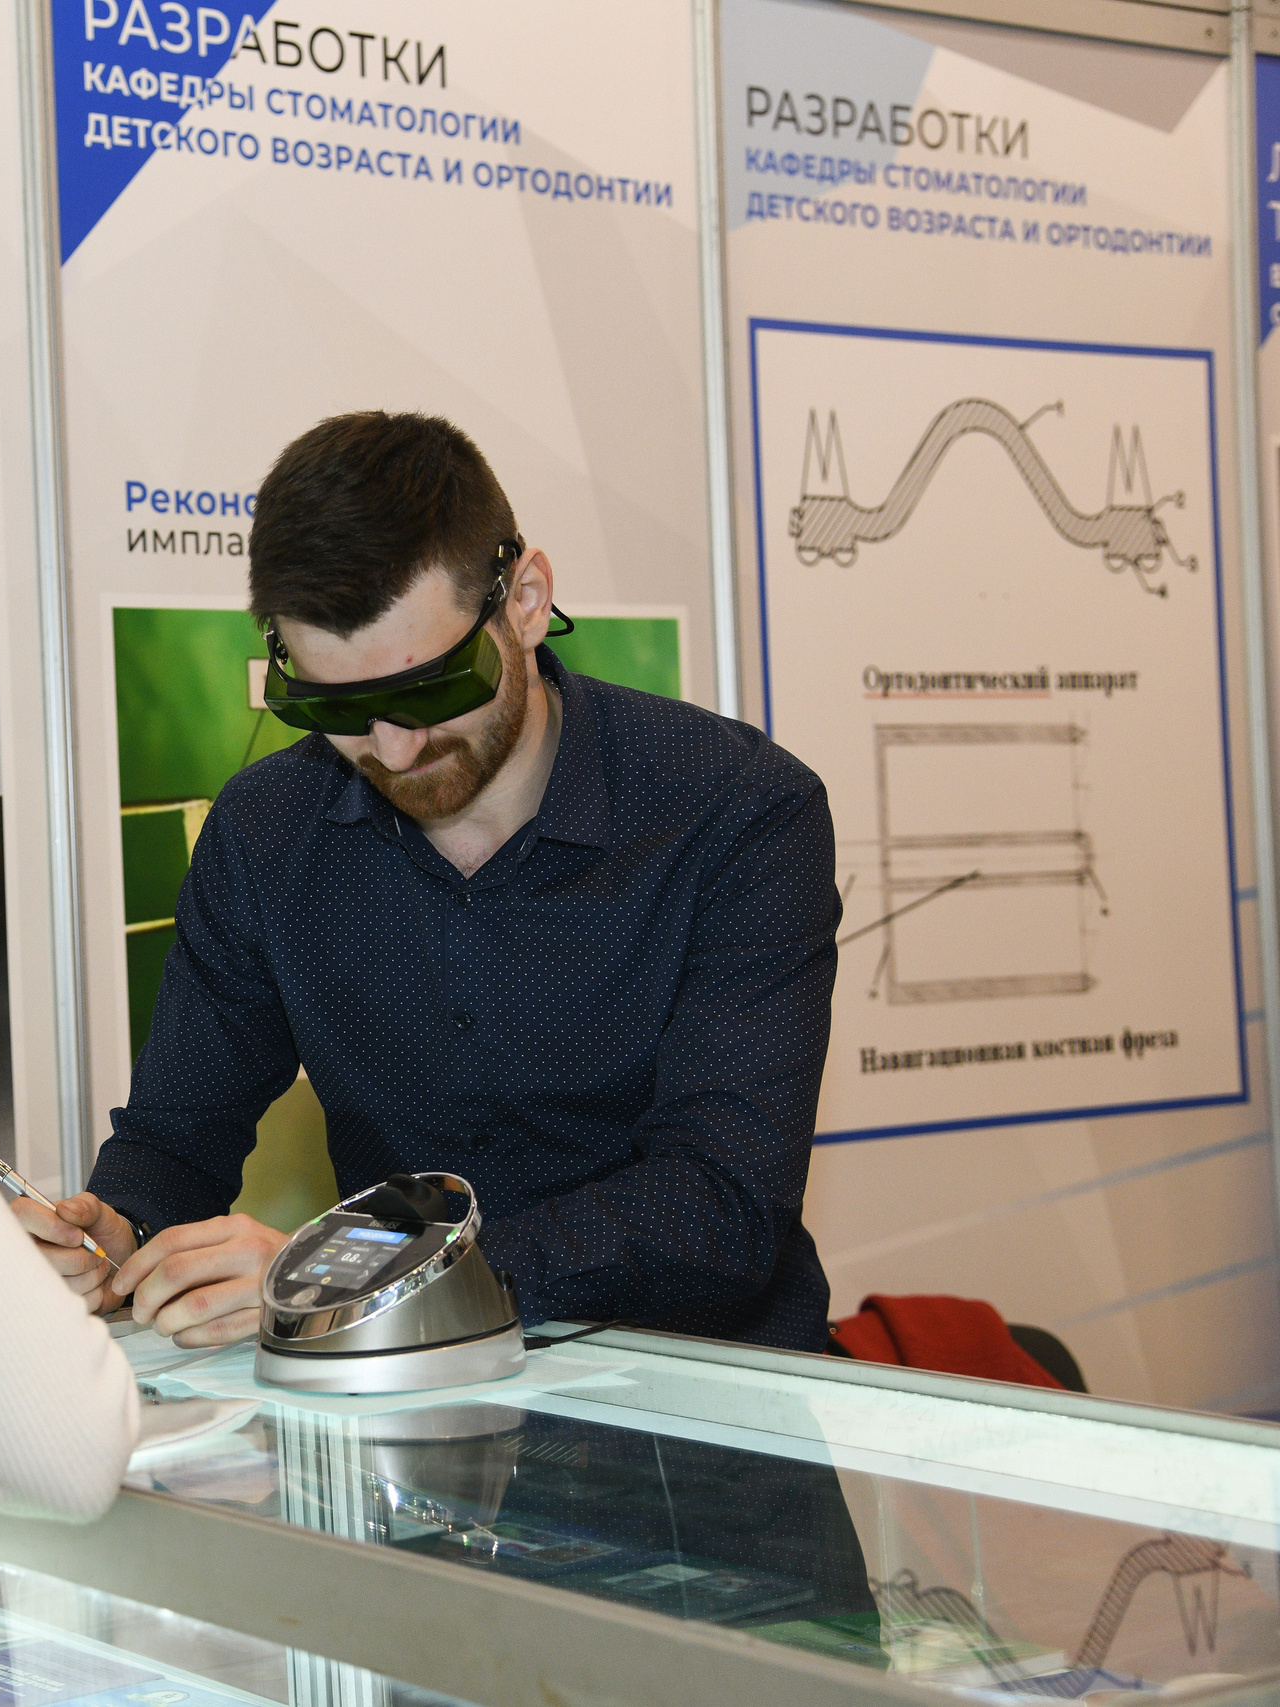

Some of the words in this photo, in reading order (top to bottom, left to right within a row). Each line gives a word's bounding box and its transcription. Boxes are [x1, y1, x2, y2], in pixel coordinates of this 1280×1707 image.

[84, 0, 446, 88] РАЗРАБОТКИ
[83, 61, 254, 111] КАФЕДРЫ
[266, 88, 521, 145] СТОМАТОЛОГИИ
[746, 84, 1028, 159] РАЗРАБОТКИ
[84, 112, 259, 161] ДЕТСКОГО
[272, 137, 432, 183] ВОЗРАСТА
[443, 159, 463, 184] И
[473, 162, 673, 208] ОРТОДОНТИИ
[745, 148, 876, 185] КАФЕДРЫ
[883, 163, 1087, 207] СТОМАТОЛОГИИ
[746, 191, 880, 228] ДЕТСКОГО
[887, 206, 1016, 242] ВОЗРАСТА
[1022, 219, 1040, 243] И
[1046, 222, 1212, 258] ОРТОДОНТИИ
[127, 528, 244, 556] импла
[862, 664, 1051, 698] Ортодонтический
[1057, 671, 1138, 698] аппарат
[860, 1040, 1026, 1073] Навигационная
[1032, 1034, 1114, 1059] костная
[340, 1252, 360, 1263] 0.8
